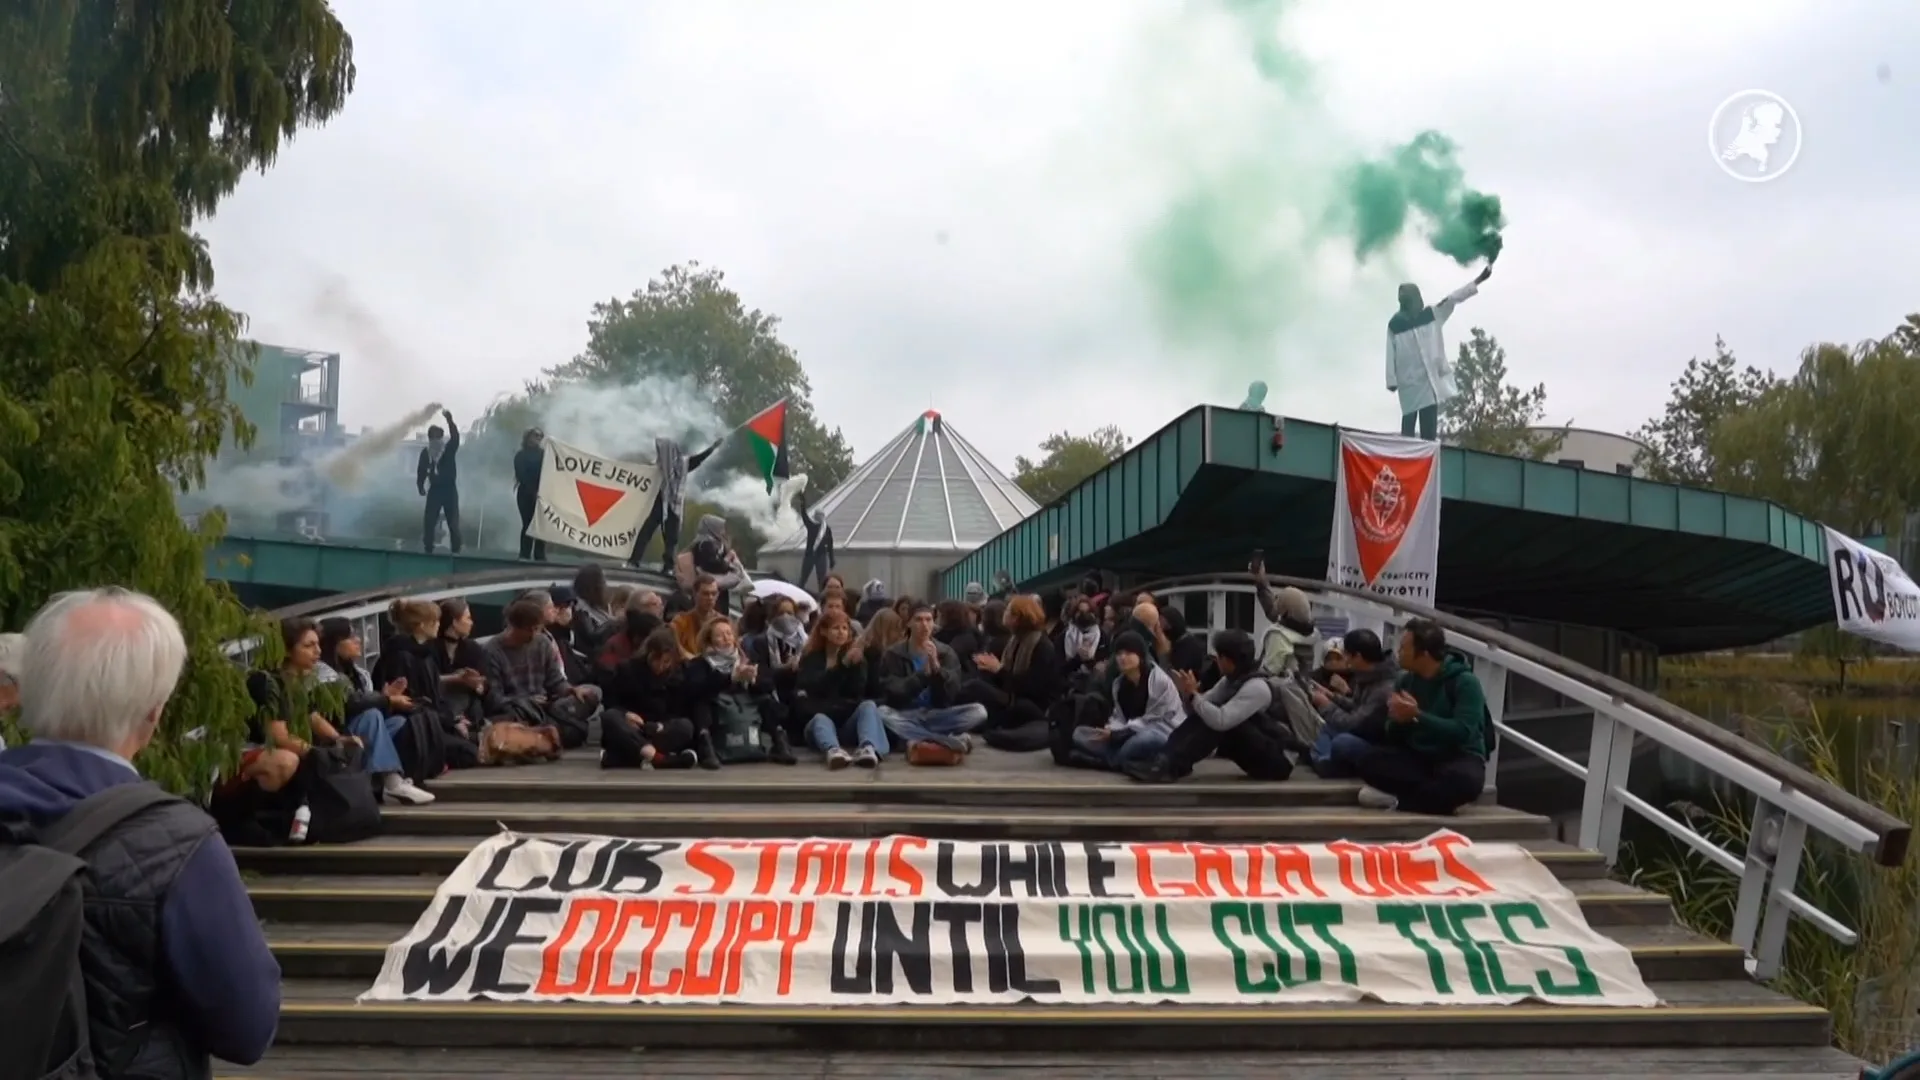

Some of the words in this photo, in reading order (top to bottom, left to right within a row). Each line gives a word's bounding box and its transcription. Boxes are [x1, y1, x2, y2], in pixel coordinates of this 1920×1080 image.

[554, 455, 603, 478] LOVE
[604, 463, 652, 493] JEWS
[543, 506, 578, 539] HATE
[578, 528, 637, 548] ZIONISM
[673, 836, 928, 897] STALLS
[936, 841, 1135, 898] WHILE
[1129, 842, 1329, 898] GAZA
[402, 896, 563, 995] WE
[533, 897, 814, 996] OCCUPY
[831, 901, 1062, 995] UNTIL
[1058, 903, 1191, 994] YOU
[1210, 902, 1359, 994] CUT
[1376, 902, 1605, 997] TIES
